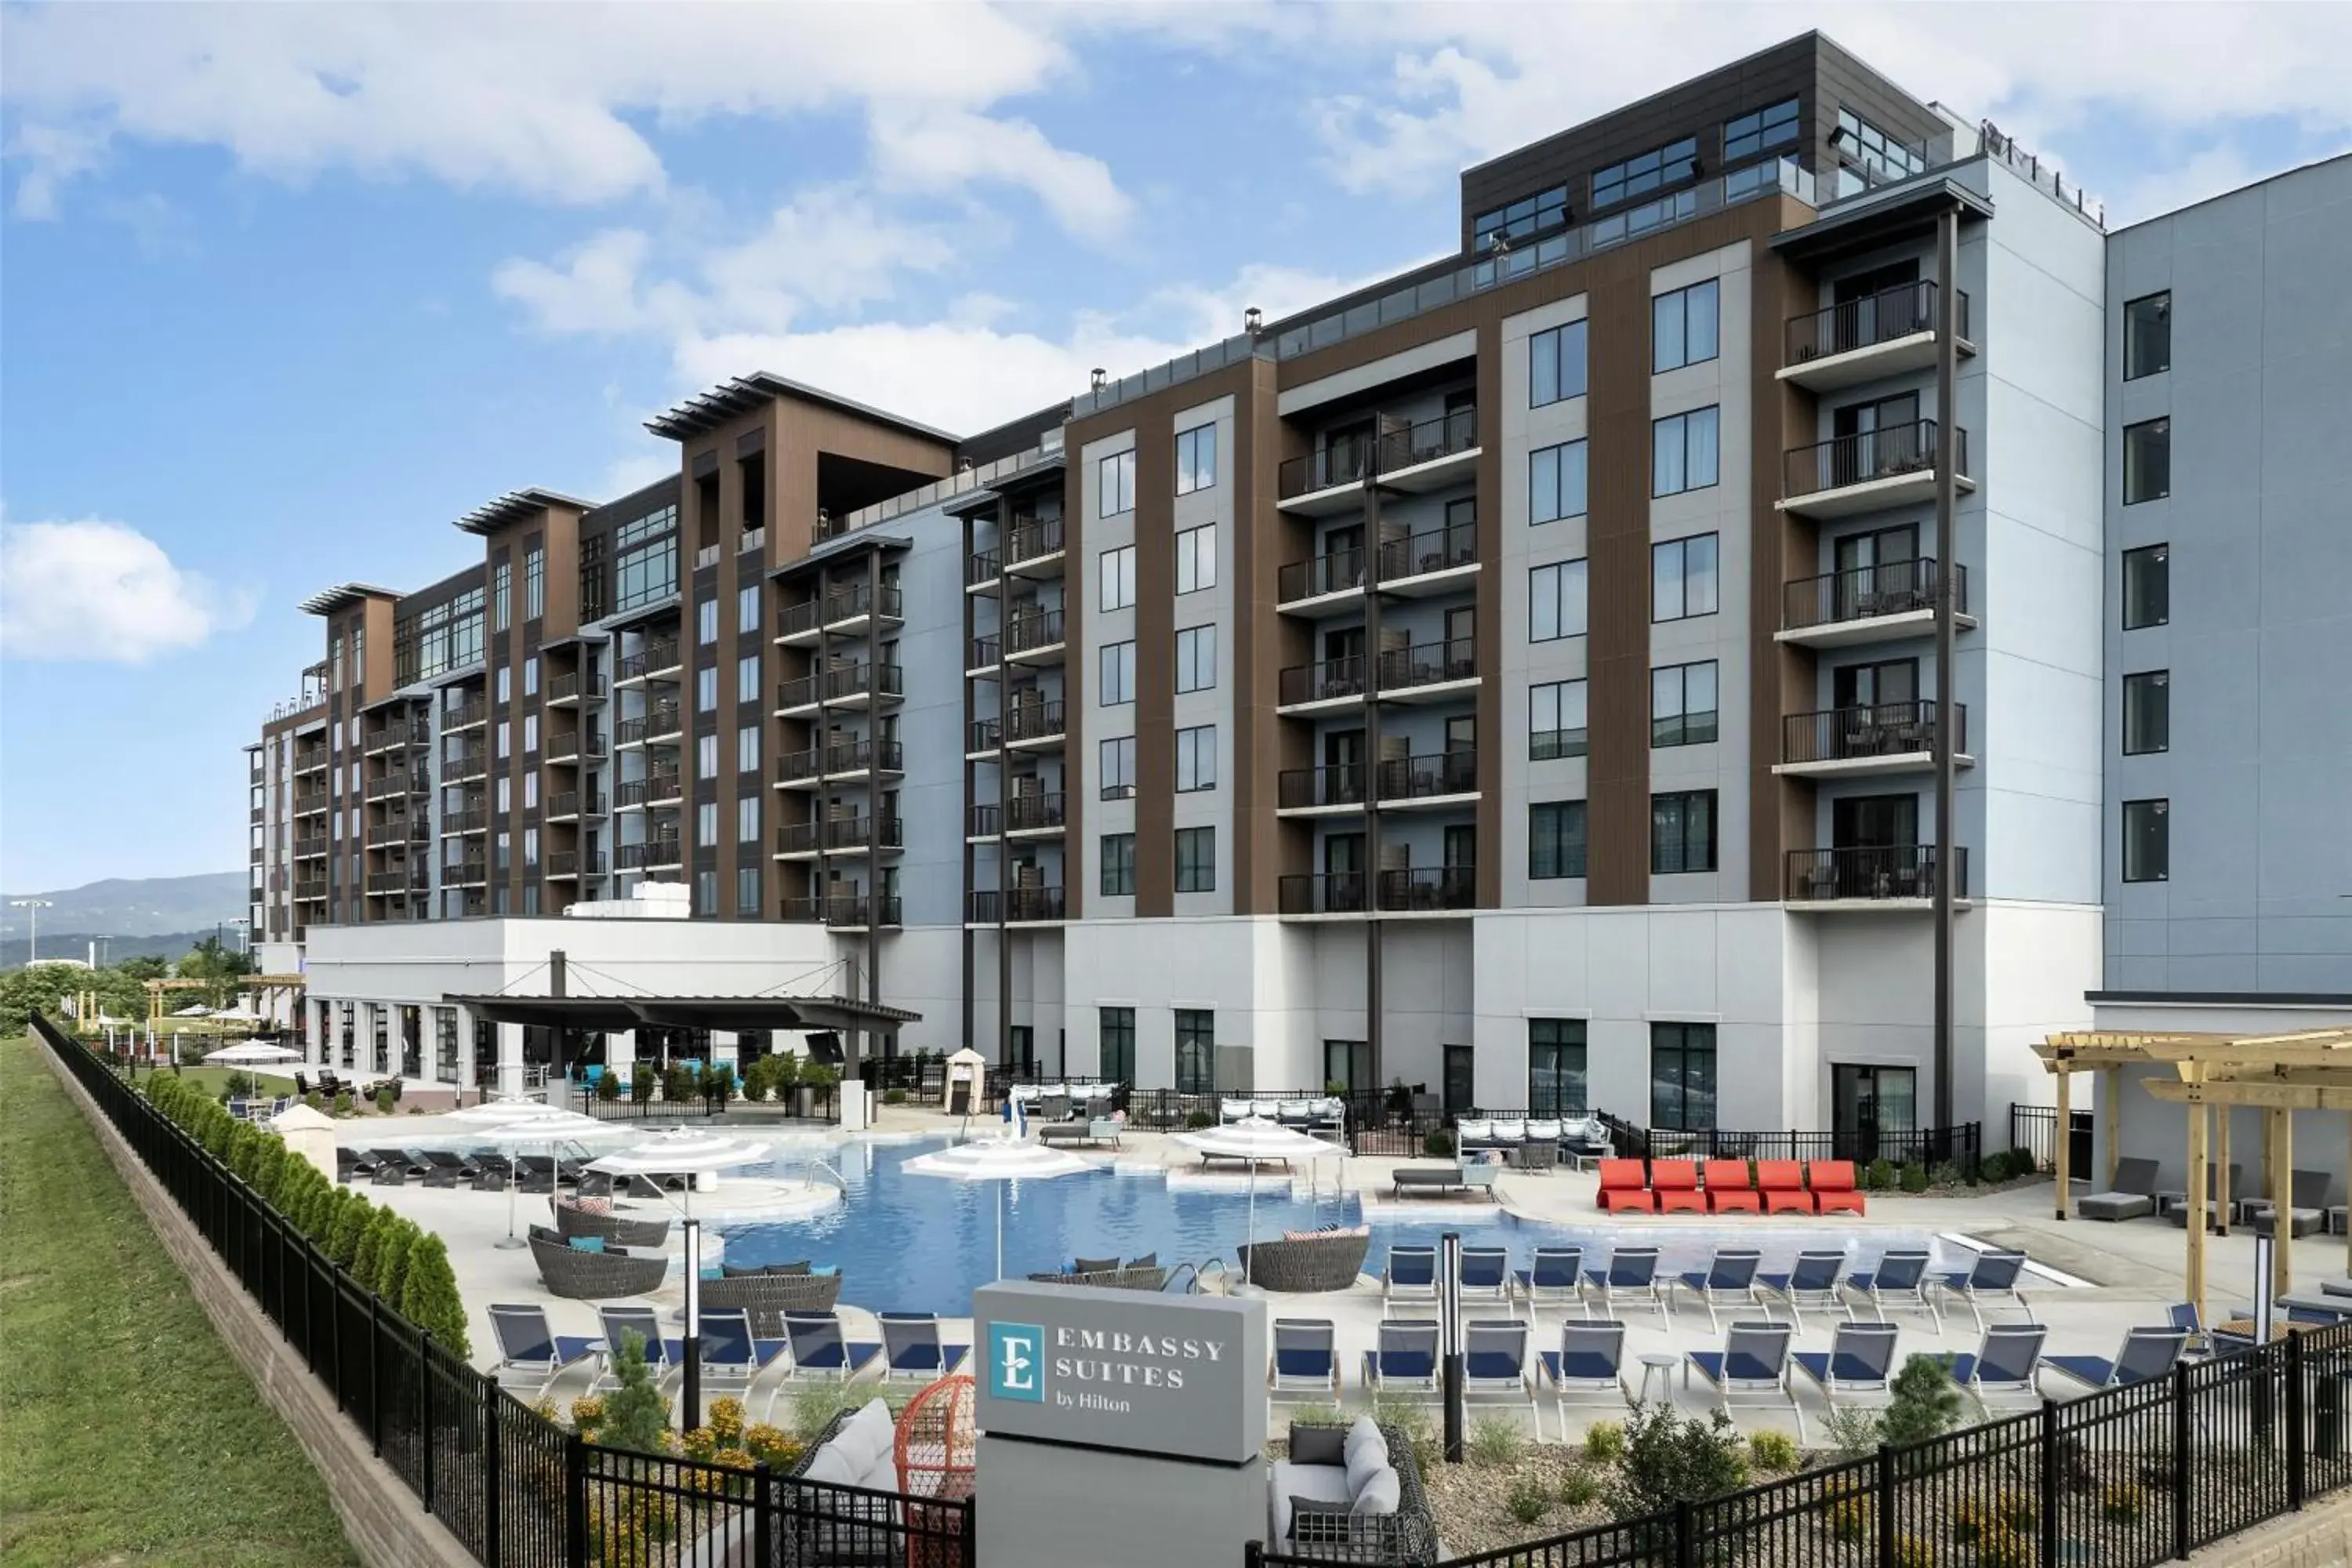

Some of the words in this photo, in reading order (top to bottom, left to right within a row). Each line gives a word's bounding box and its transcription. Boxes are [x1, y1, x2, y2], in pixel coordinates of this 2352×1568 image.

[1056, 1327, 1225, 1361] EMBASSY
[1001, 1337, 1033, 1390] E
[1056, 1358, 1184, 1388] SUITES
[1056, 1391, 1074, 1408] by
[1079, 1392, 1131, 1412] Hilton
